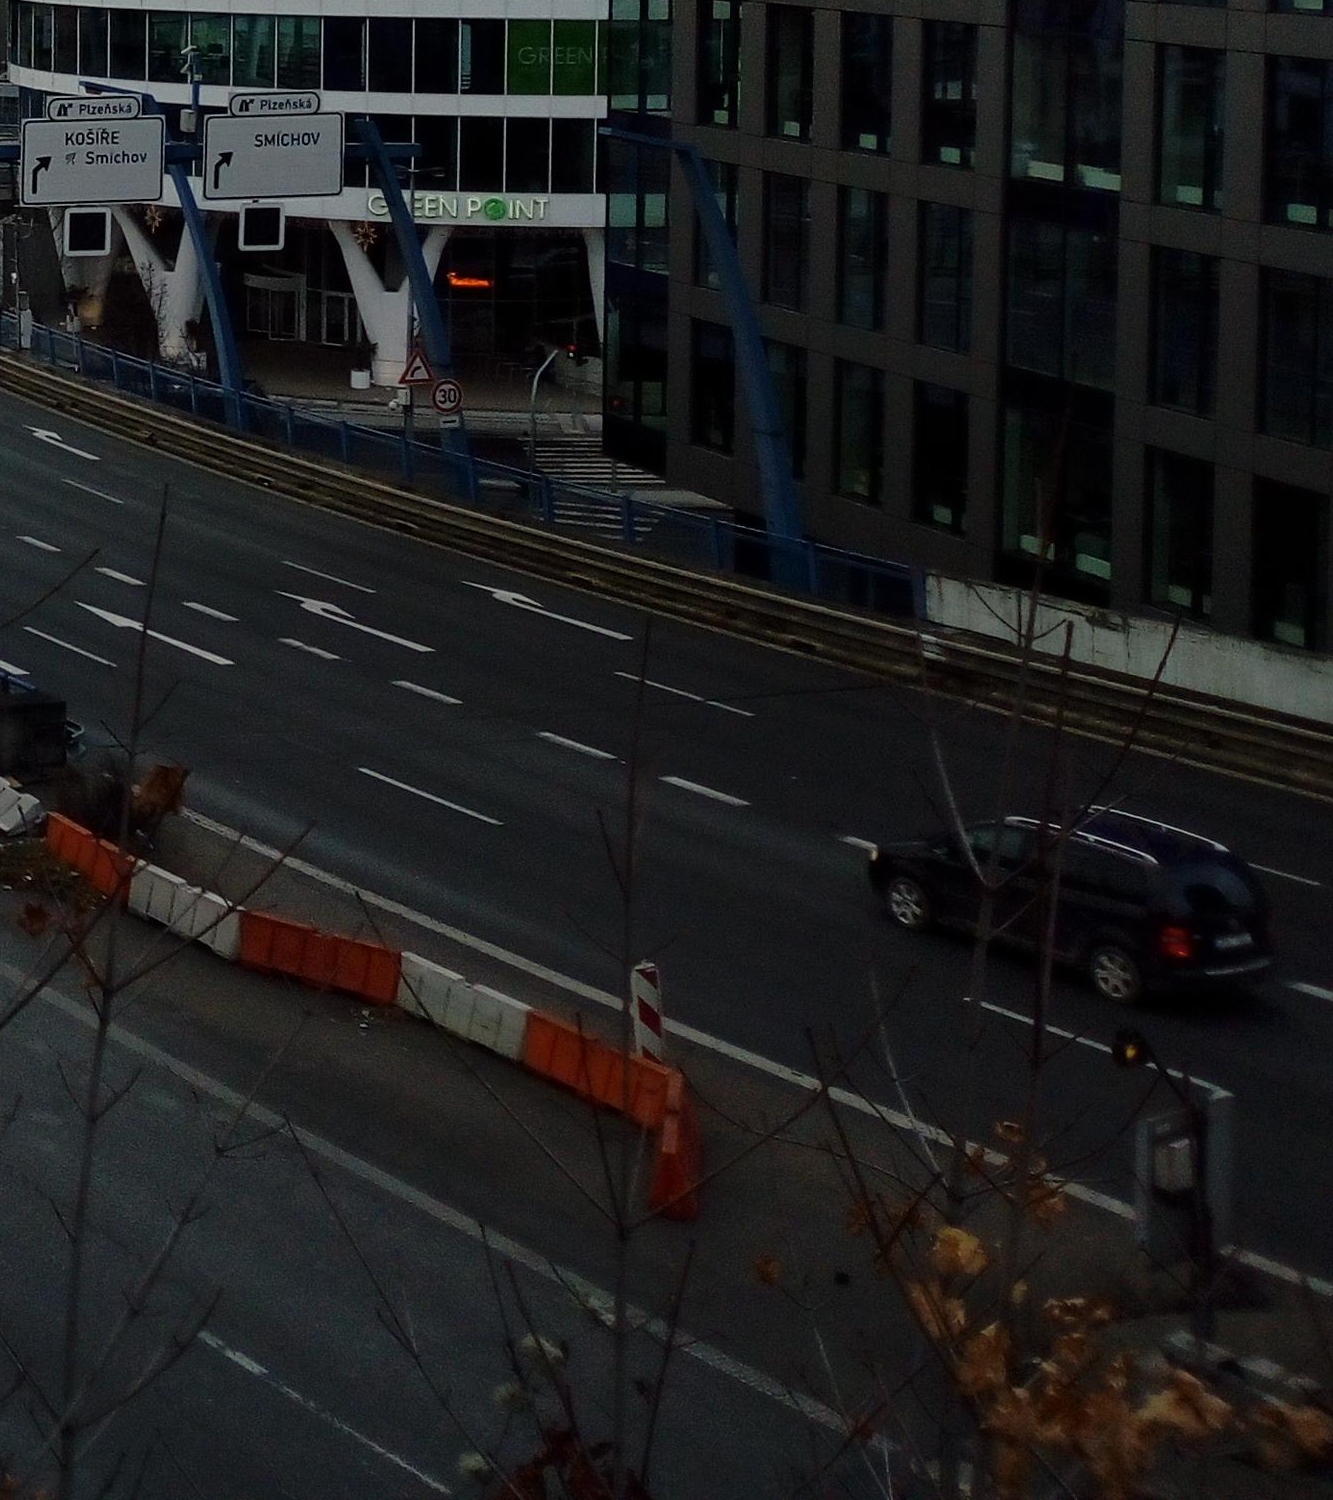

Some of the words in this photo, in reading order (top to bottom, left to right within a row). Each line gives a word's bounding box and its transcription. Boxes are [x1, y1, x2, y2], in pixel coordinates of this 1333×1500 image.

[517, 45, 594, 66] GREEN
[78, 102, 133, 116] Plzeňská
[259, 97, 313, 111] Plzeňská
[64, 127, 120, 146] KOŠÍŘE
[253, 130, 321, 148] SMÍCHOV
[367, 194, 458, 219] GEEN
[438, 387, 458, 405] 30
